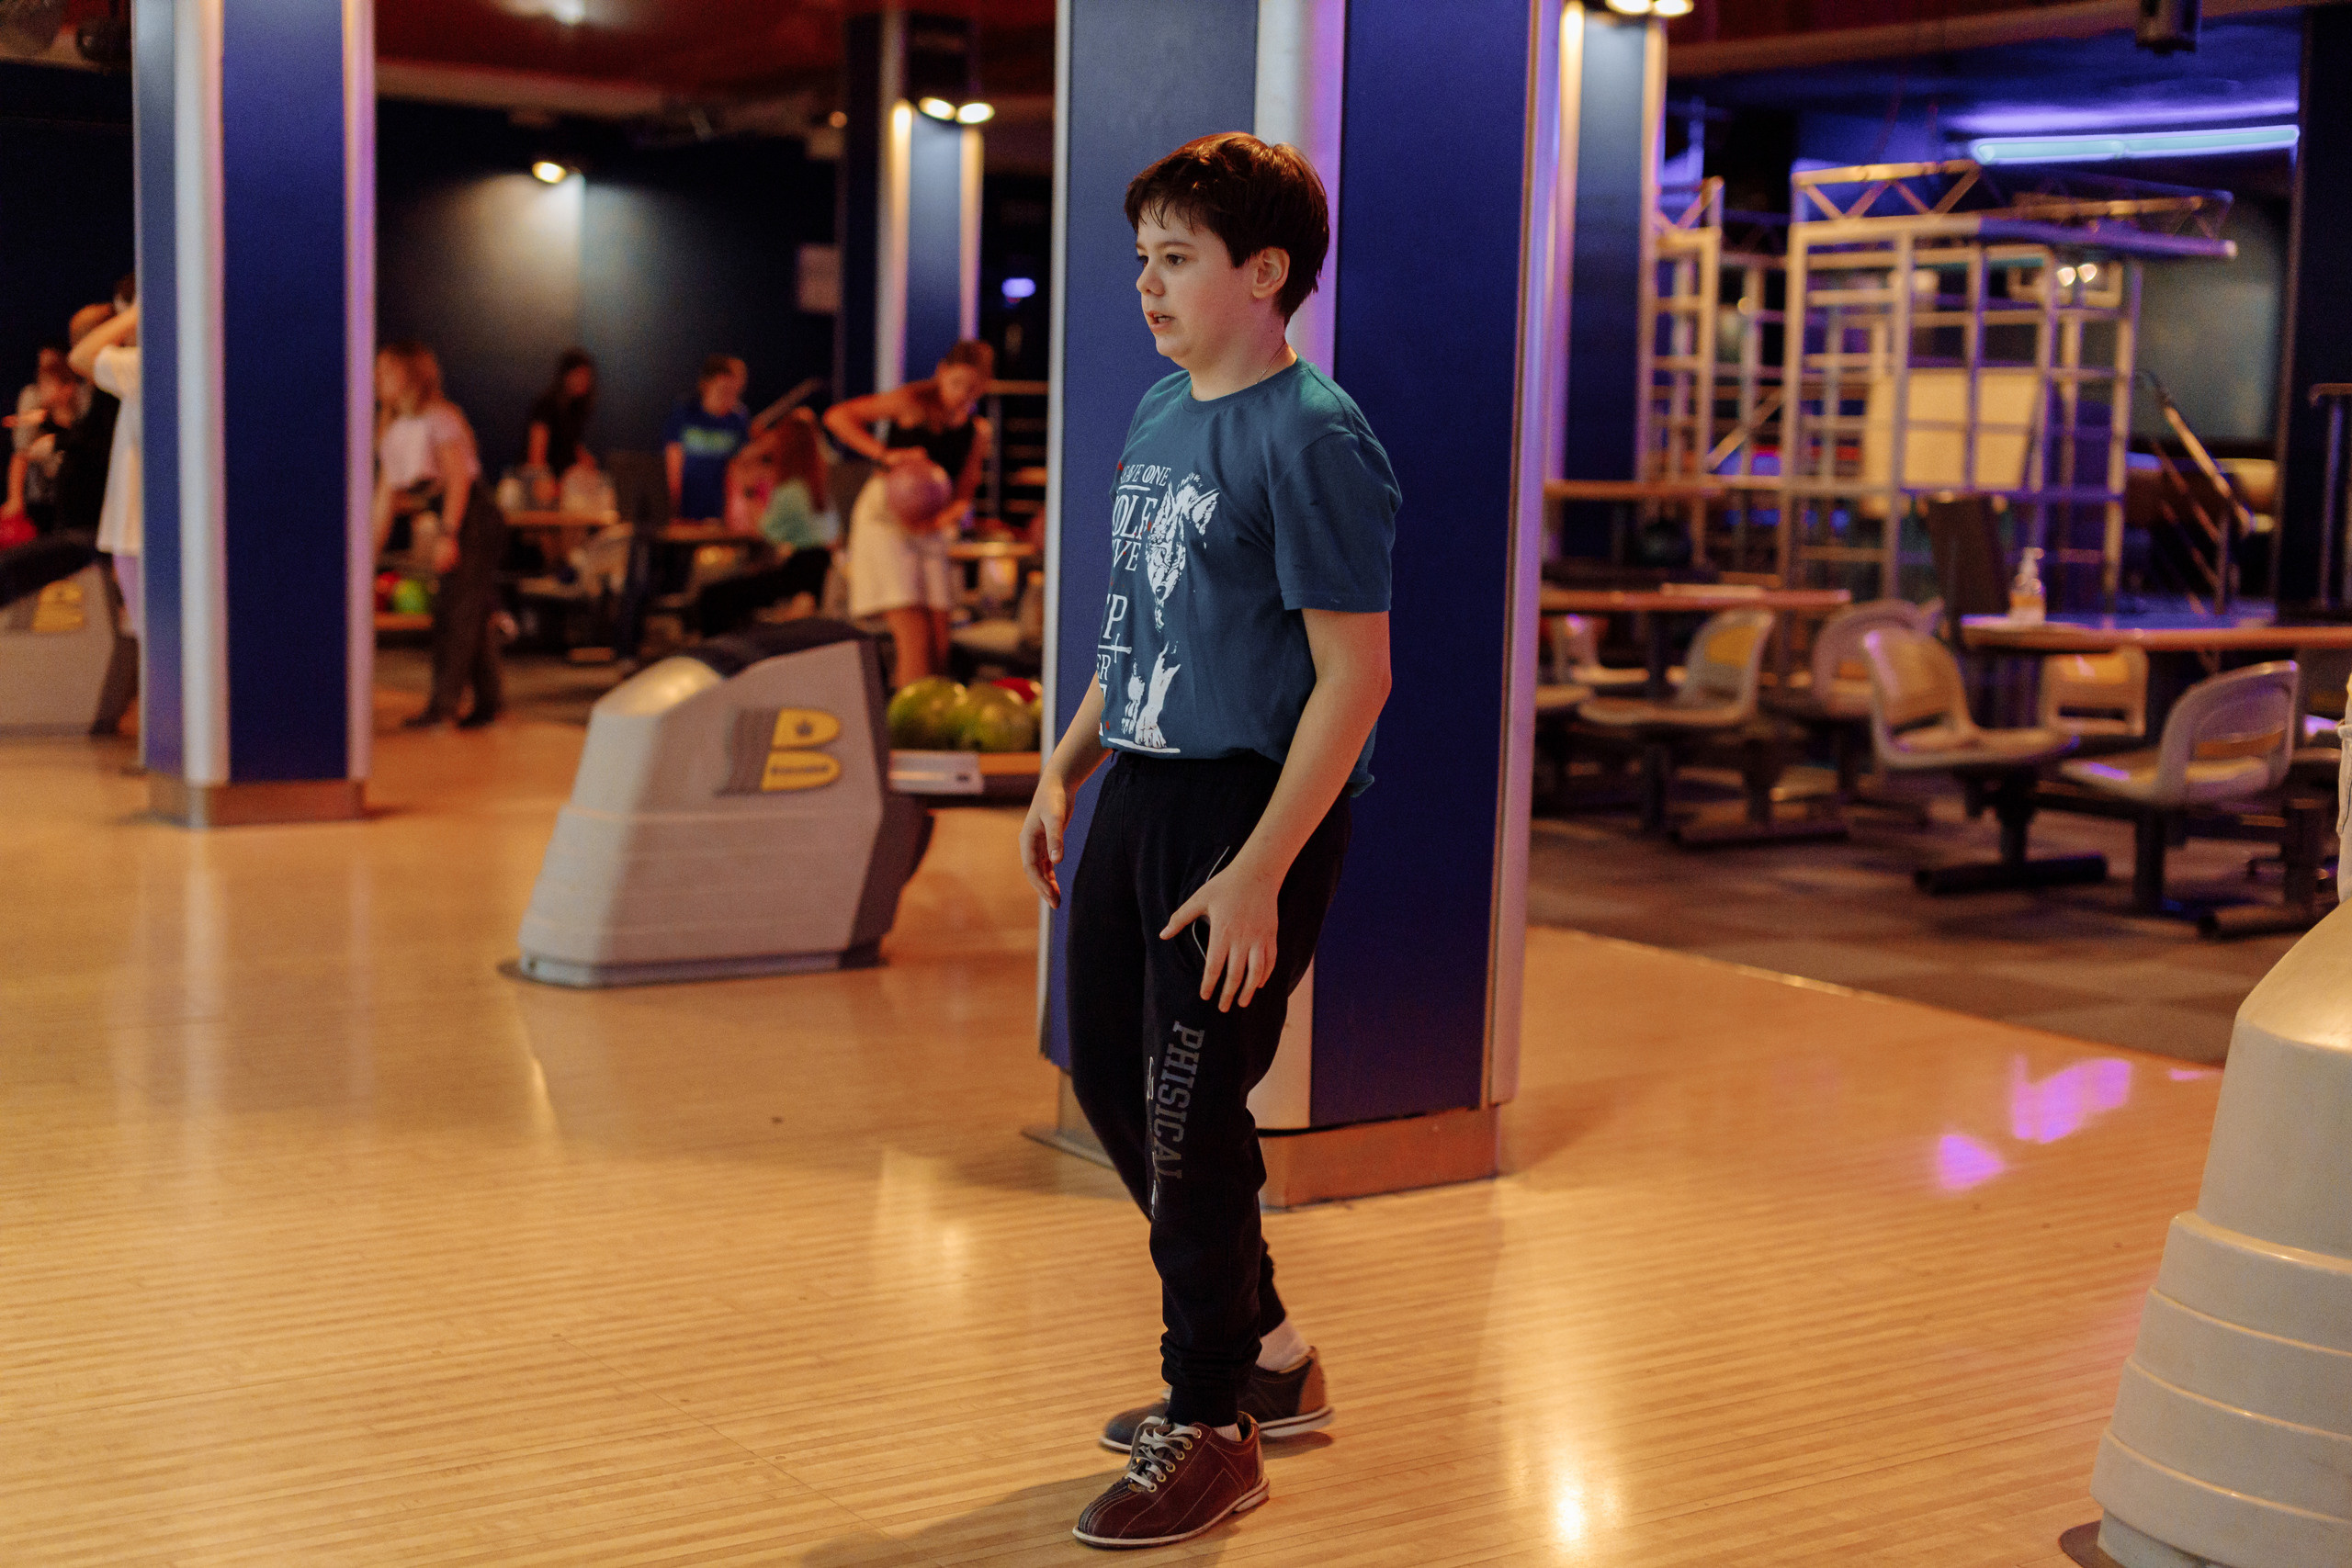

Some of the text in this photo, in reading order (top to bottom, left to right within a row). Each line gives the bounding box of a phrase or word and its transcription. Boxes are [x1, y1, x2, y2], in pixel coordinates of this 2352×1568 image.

[1141, 465, 1171, 487] ONE
[1112, 494, 1159, 540] OLF
[1151, 1021, 1205, 1185] PHISICAL
